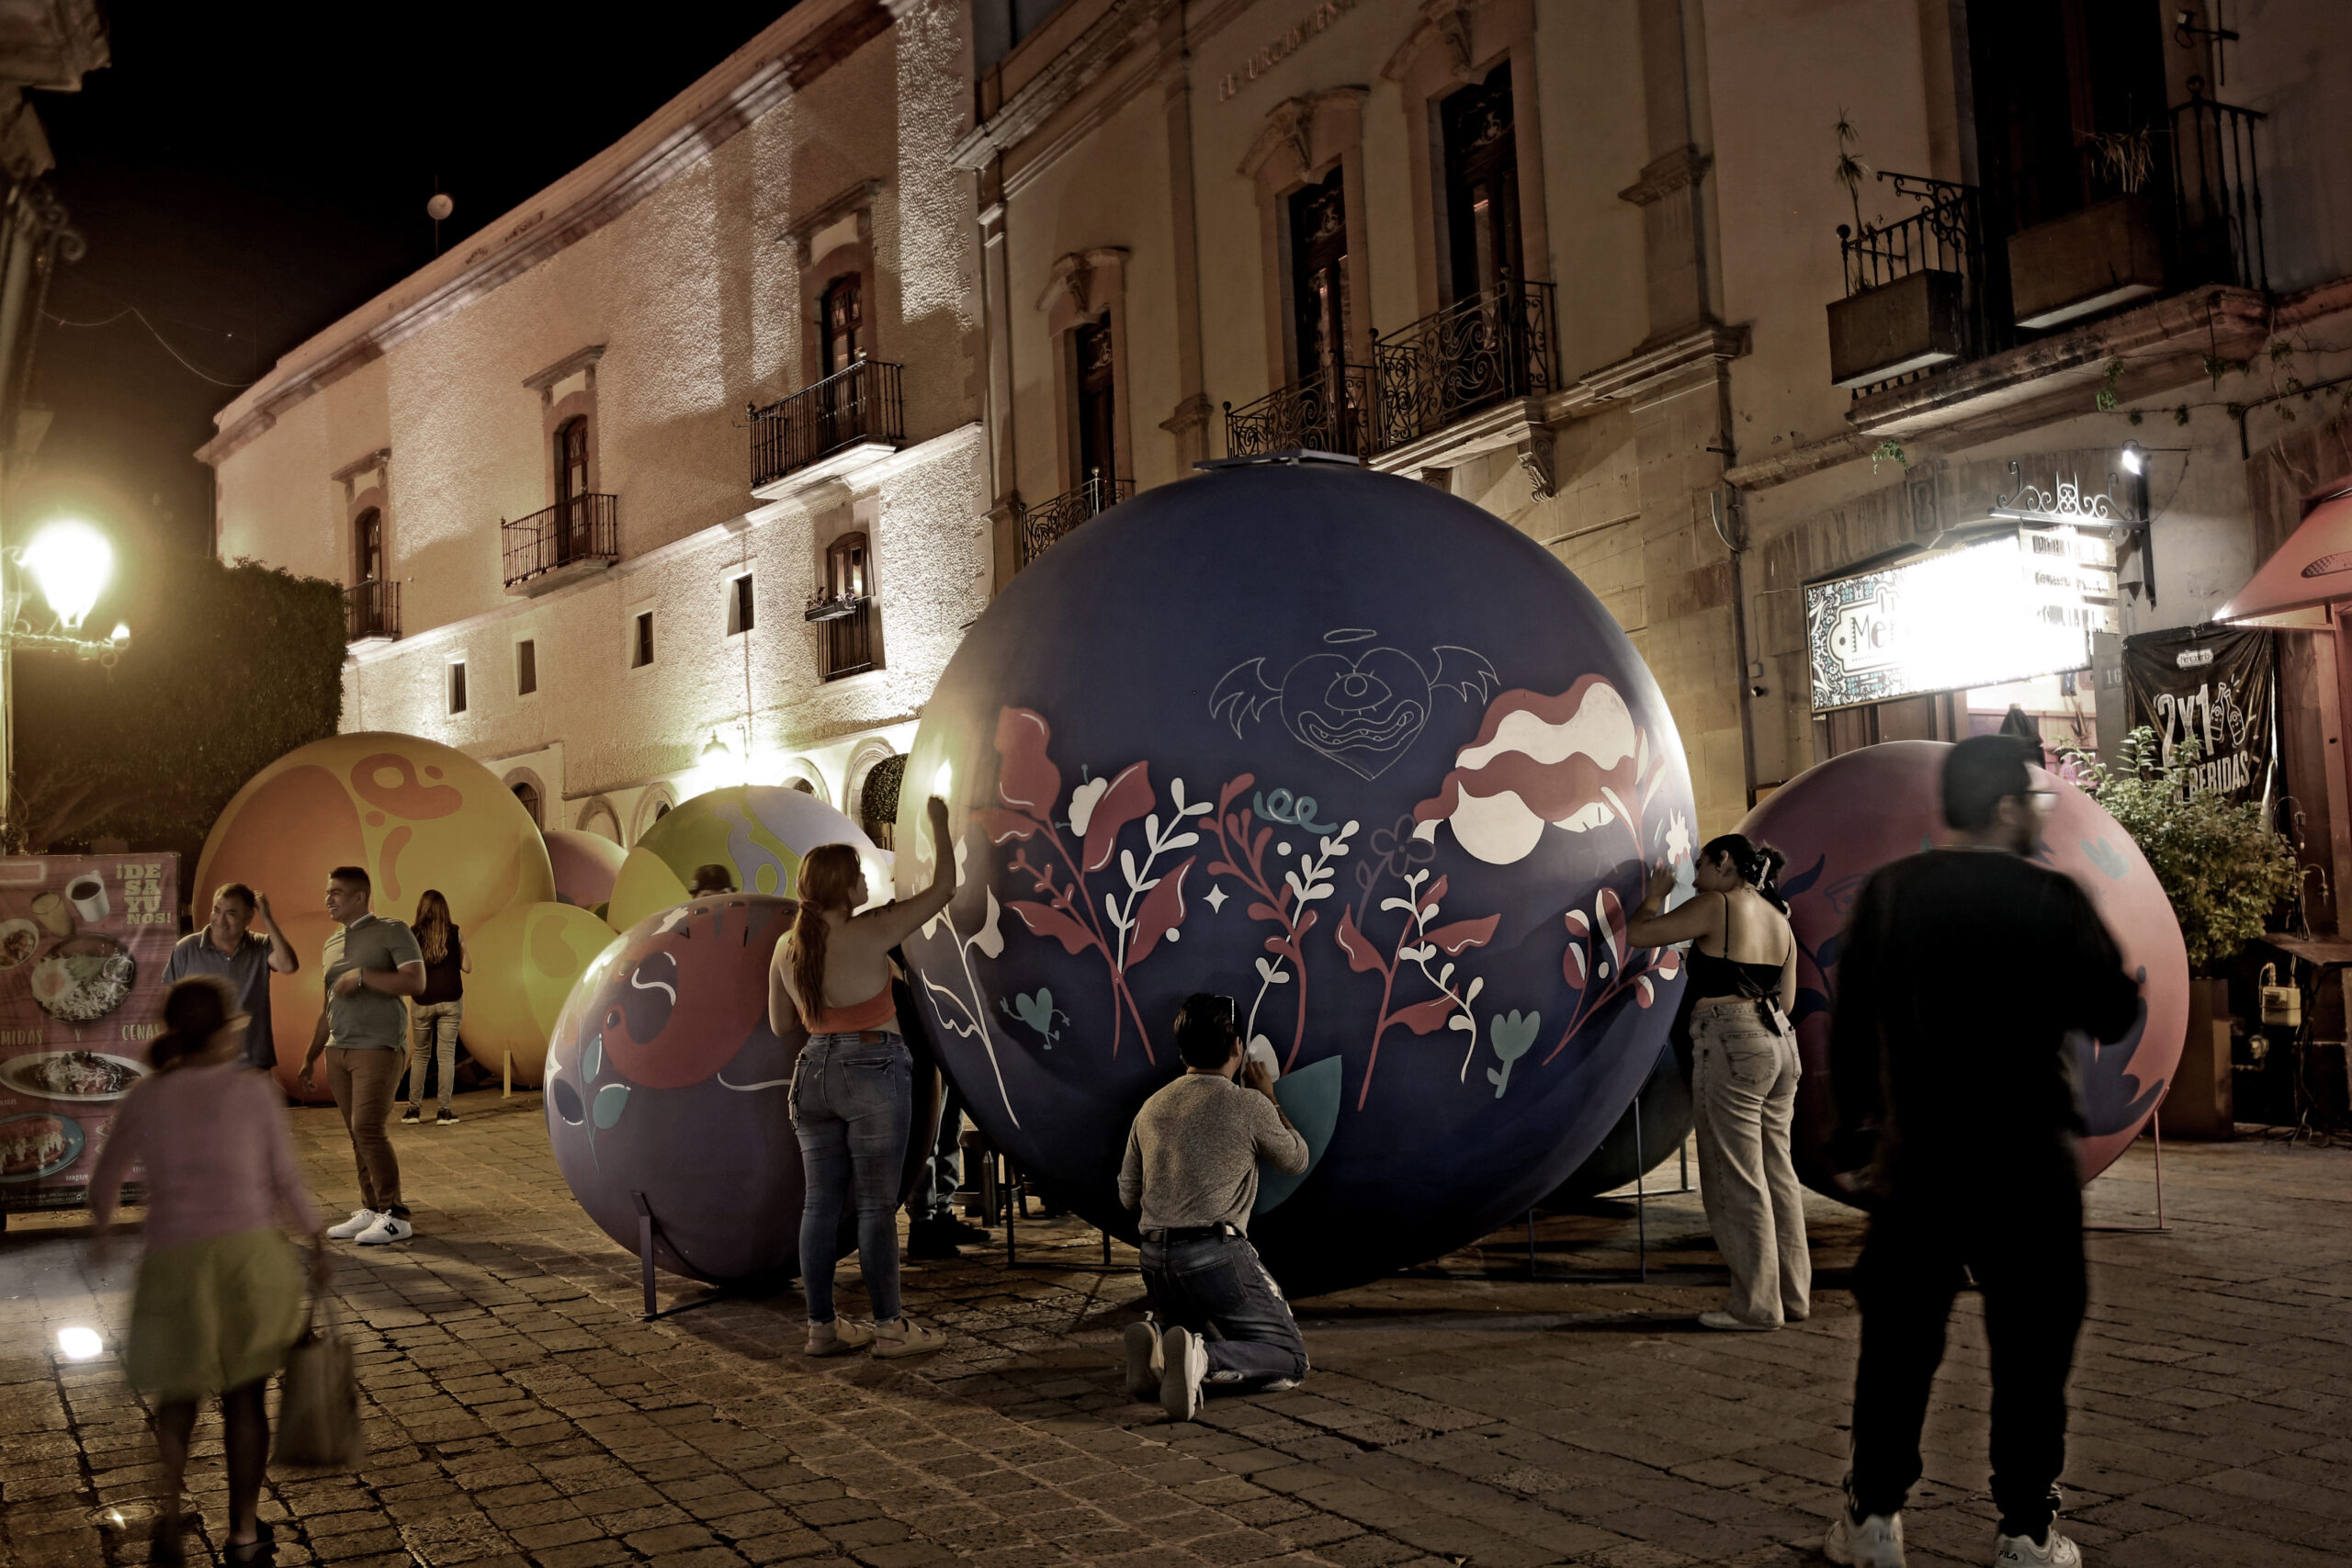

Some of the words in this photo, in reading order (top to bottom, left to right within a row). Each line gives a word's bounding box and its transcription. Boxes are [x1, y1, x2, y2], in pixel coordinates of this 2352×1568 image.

[2107, 669, 2121, 684] 16
[2188, 750, 2250, 799] BEBIDAS
[124, 879, 162, 897] SA
[123, 896, 163, 912] YU
[126, 911, 172, 925] NOS!
[74, 1029, 83, 1043] Y
[1998, 1550, 2018, 1561] FILA
